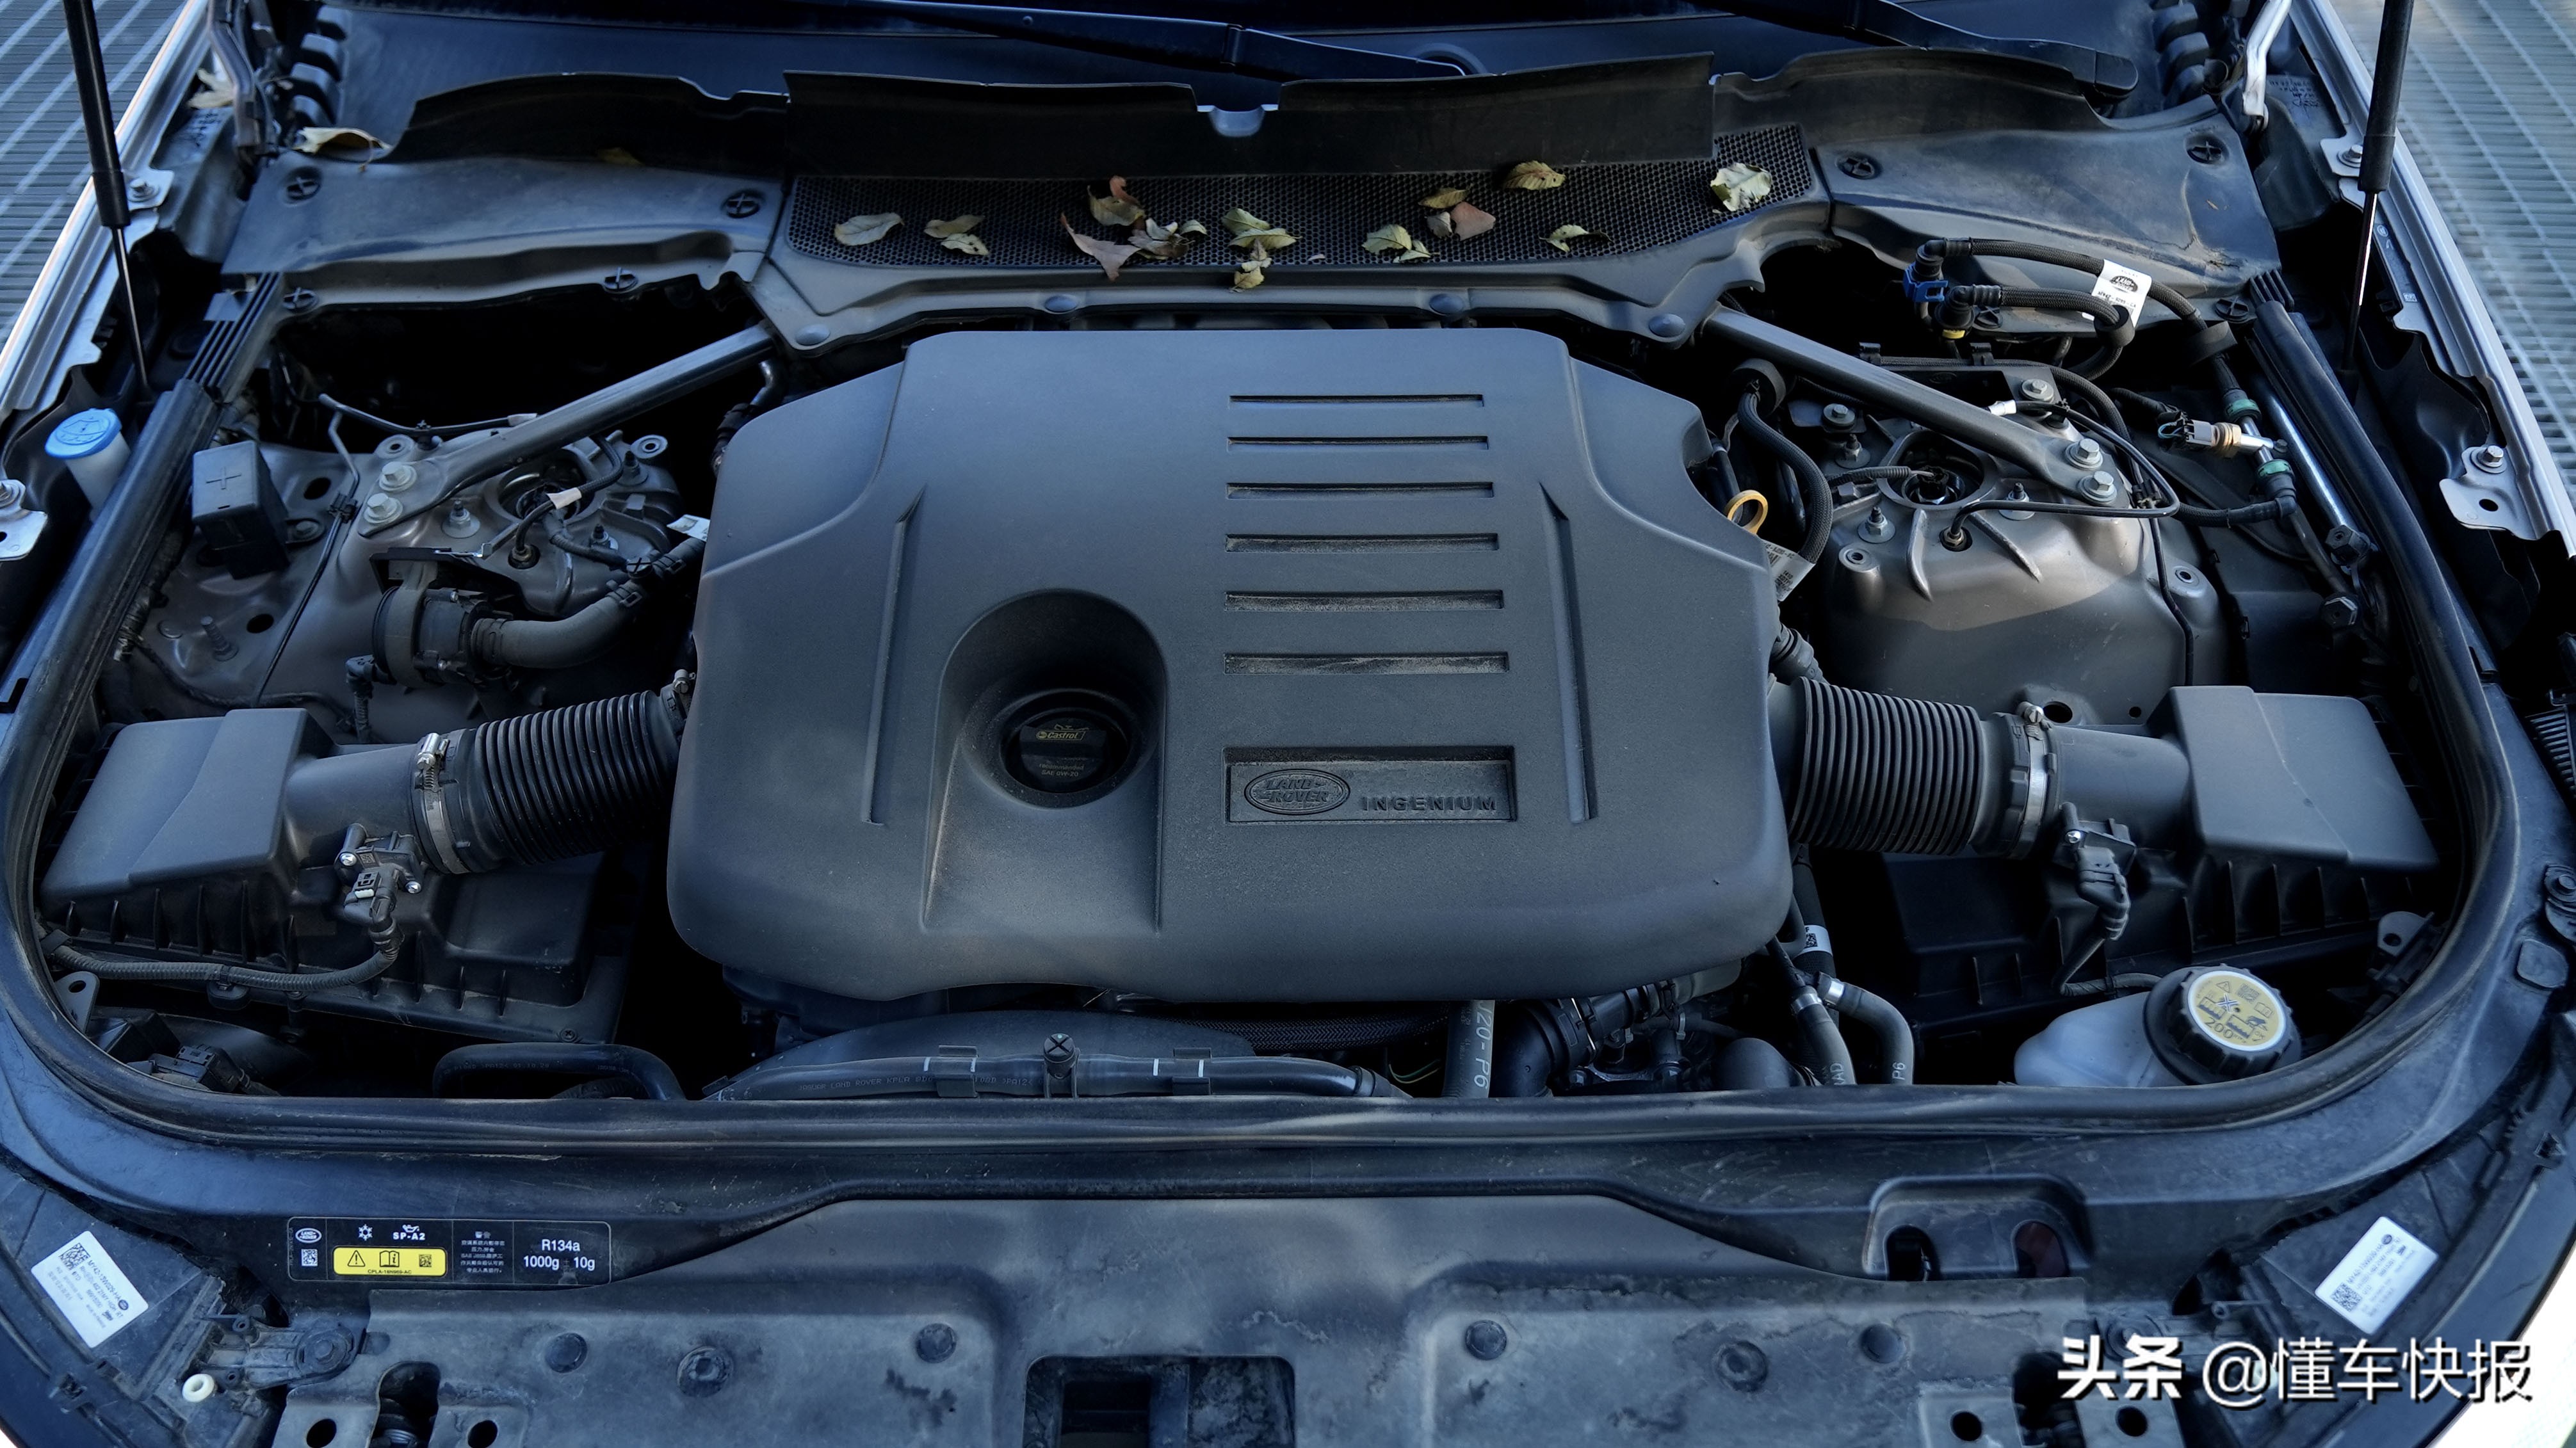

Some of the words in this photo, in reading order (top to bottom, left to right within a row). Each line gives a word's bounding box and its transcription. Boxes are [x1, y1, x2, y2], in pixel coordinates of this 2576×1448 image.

[1266, 778, 1313, 790] LAND
[1270, 790, 1329, 803] ROVER
[1362, 796, 1497, 812] INGENIUM
[2205, 1017, 2233, 1039] 200
[1891, 1061, 1906, 1081] P6
[393, 1232, 426, 1241] SP-A2
[542, 1239, 581, 1252] R134a
[523, 1255, 560, 1271] 1000g
[574, 1257, 595, 1271] 10g
